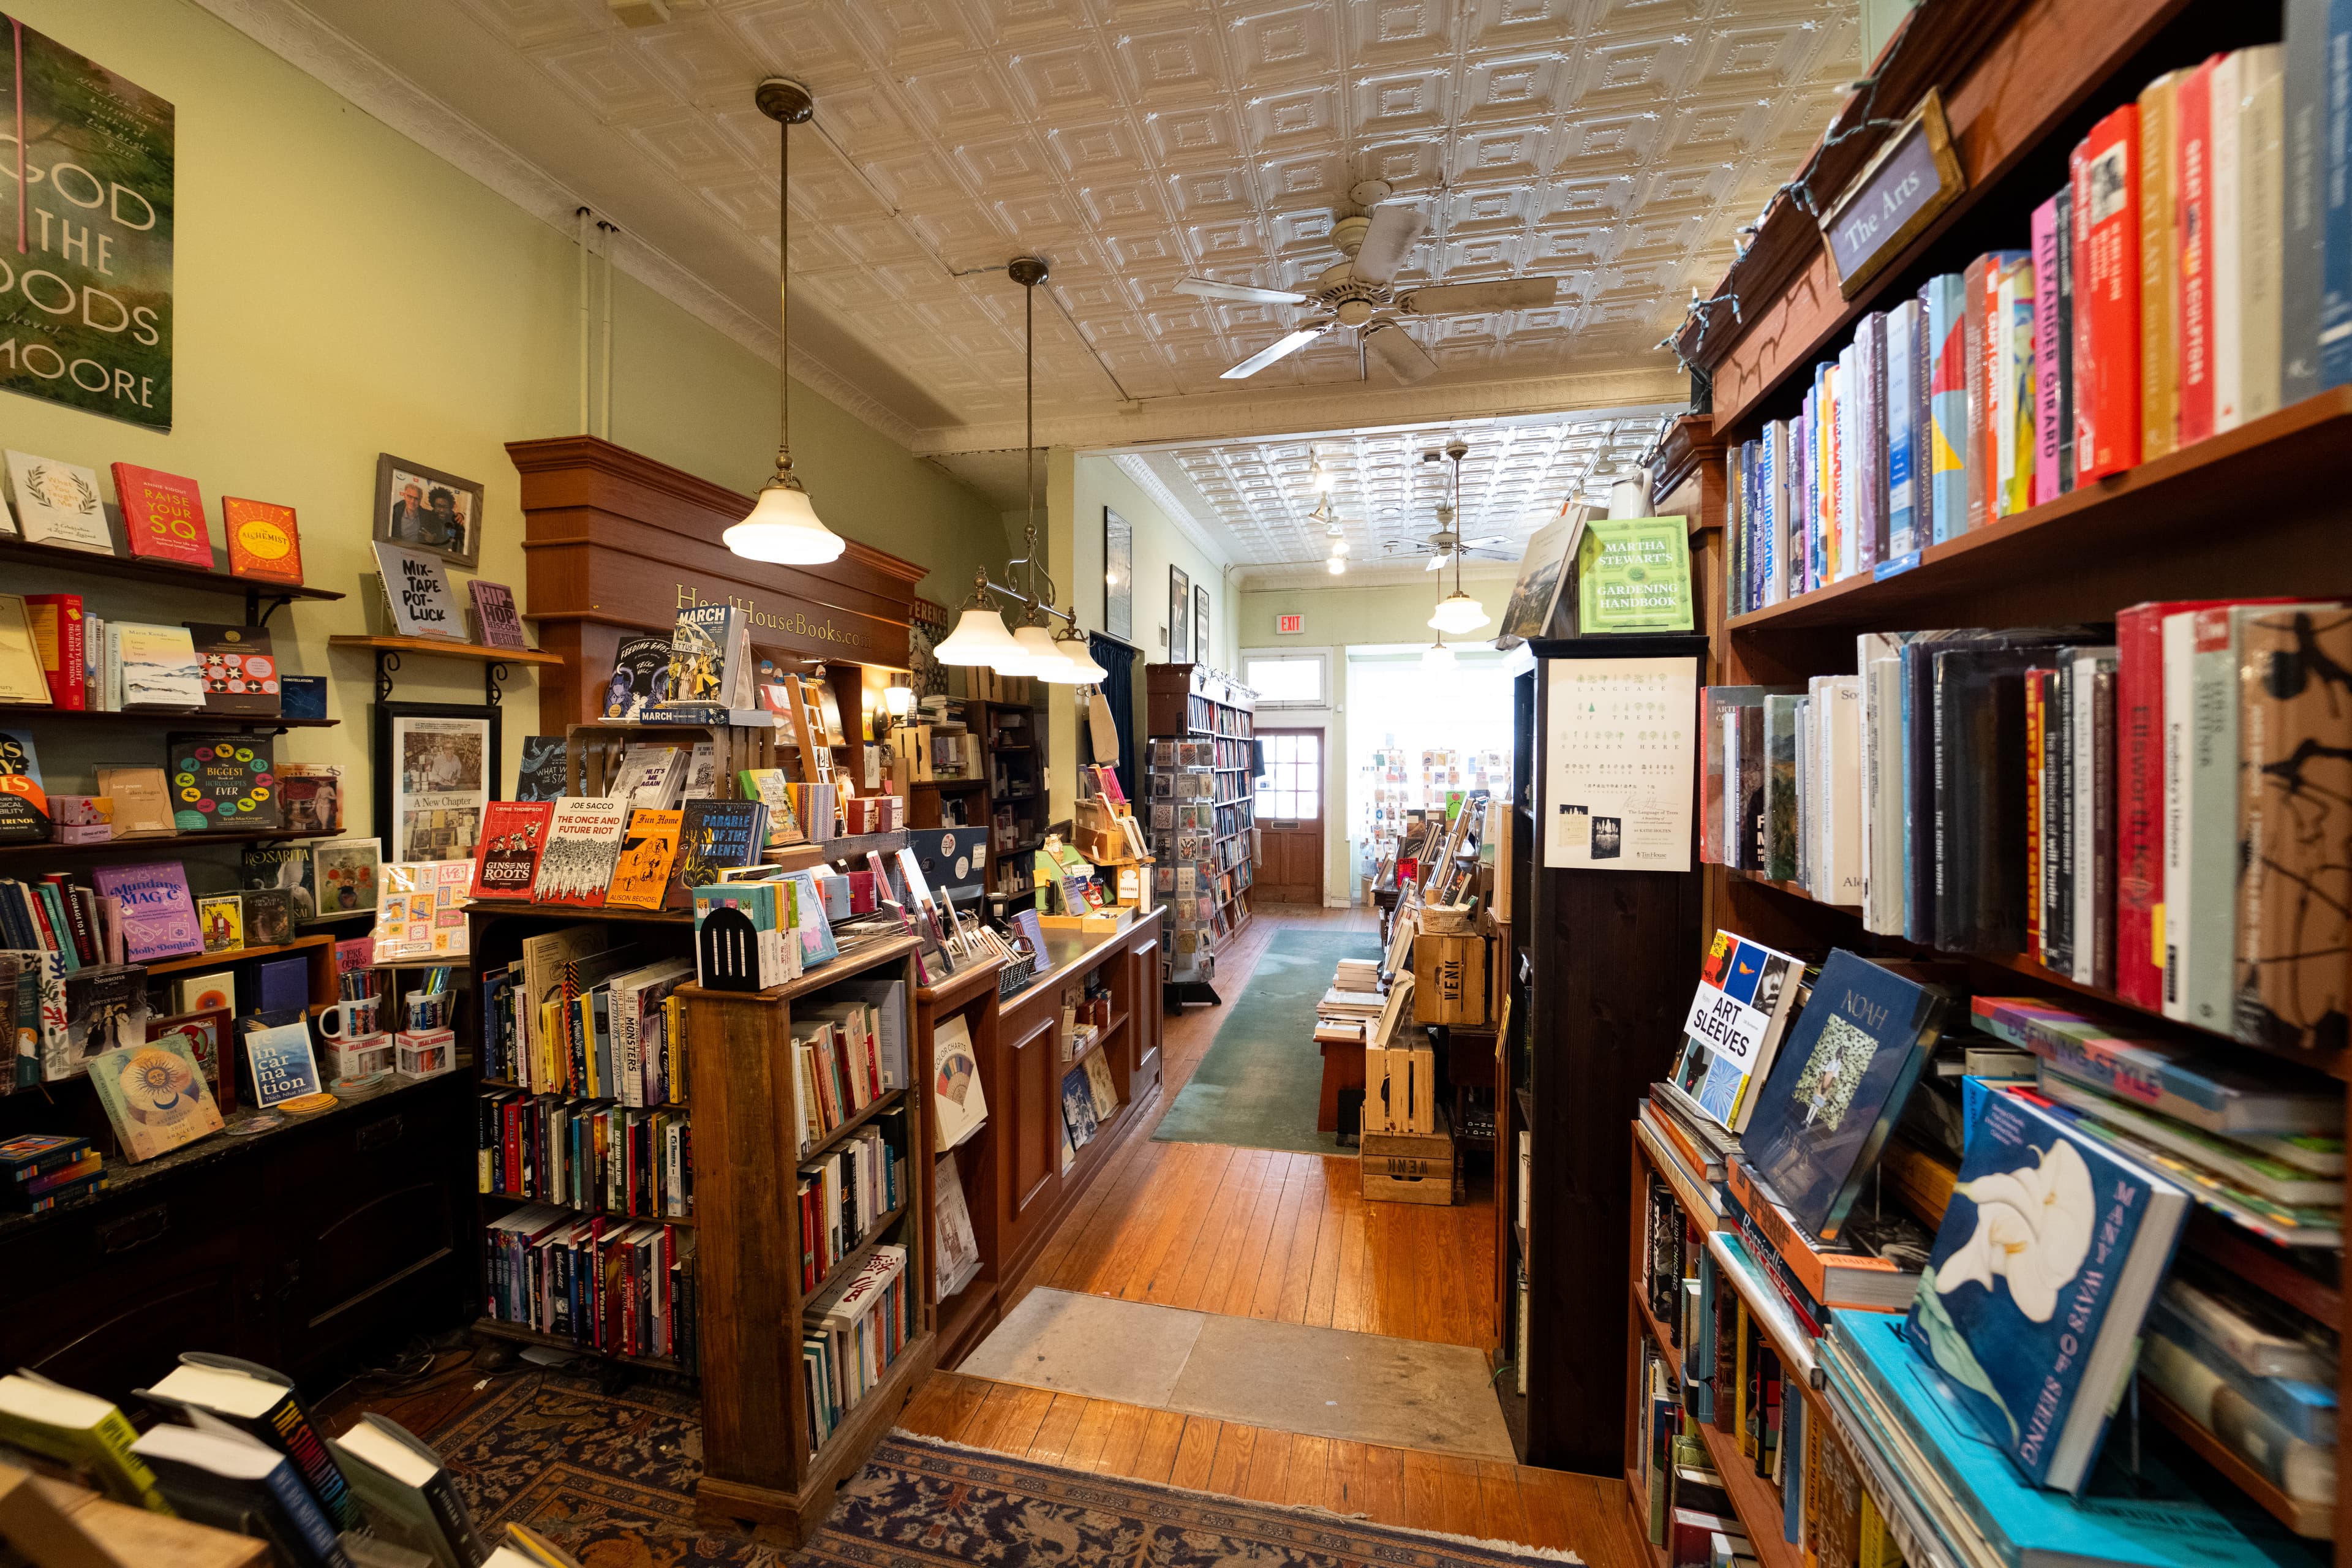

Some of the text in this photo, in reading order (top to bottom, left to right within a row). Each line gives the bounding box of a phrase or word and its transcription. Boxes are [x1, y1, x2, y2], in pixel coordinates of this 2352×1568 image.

[1844, 170, 1921, 254] The Arts
[35, 208, 113, 276] THE
[0, 258, 159, 345] ODS
[7, 312, 61, 336] Novel
[2041, 233, 2059, 459] ALEXANDER GIRARD
[143, 481, 164, 491] ANNIE
[144, 489, 190, 507] RAISE
[147, 500, 191, 519] YOUR
[149, 514, 197, 541] SQ
[243, 532, 288, 545] ALCHEMIST
[1605, 540, 1665, 552] MARTHA
[402, 559, 433, 576] MIX-
[1598, 552, 1673, 566] STEWART'S
[406, 576, 442, 594] TAPE
[1596, 583, 1678, 595] GARDENING
[402, 590, 433, 606] POT-
[478, 586, 513, 606] HIP-
[1599, 596, 1678, 609] HANDBOOK
[410, 605, 446, 622] LUCK
[676, 583, 872, 649] HeHouseBooks.com
[678, 608, 726, 625] MARCH
[487, 621, 521, 631] HISTORY
[1281, 616, 1300, 631] EXIT
[620, 642, 650, 660] FEEDING
[642, 711, 673, 721] MARCH
[207, 767, 244, 776] BIGGEST
[1934, 745, 1943, 791] BASQUIAT
[216, 786, 238, 796] EVER
[413, 796, 472, 808] A New Chapter
[2129, 706, 2150, 910] Ellsworth Kelly
[557, 815, 620, 825] THE ONCE AND
[636, 813, 679, 825] Fun Home
[703, 815, 750, 827] PARABLE
[1934, 810, 1943, 828] THE
[2045, 731, 2059, 909] the architecture of will bruder
[558, 826, 614, 835] FUTURE RIOT
[714, 829, 748, 842] OF THE
[245, 848, 309, 866] ROSARITA
[699, 843, 745, 857] TALENTS
[486, 861, 531, 870] GINSENG
[483, 869, 530, 881] ROOTS
[1935, 863, 1943, 896] WORKS
[110, 878, 182, 897] Mundane
[120, 889, 179, 907] MAGC
[631, 895, 658, 903] BECHDEL
[70, 894, 82, 921] COURAGE
[129, 947, 155, 956] Molly
[94, 974, 126, 985] Seasons
[1444, 961, 1460, 1001] WENK
[1713, 997, 1743, 1026] ART
[1840, 989, 1888, 1030] NOAH
[573, 1020, 584, 1058] NOTHING SPECIAL
[1694, 1009, 1749, 1057] SLEEVES
[255, 1046, 277, 1060] in
[625, 1017, 636, 1072] MONSTERS
[257, 1054, 288, 1071] car
[934, 1042, 967, 1071] COLOR CHARTS
[259, 1066, 287, 1082] na
[262, 1076, 306, 1095] tion
[1387, 1158, 1428, 1174] WENK
[2020, 1179, 2136, 1467] MANY WAYS OF SEEING
[271, 1400, 345, 1501] THE STIMULATED
[1809, 1467, 1817, 1510] TALKING
